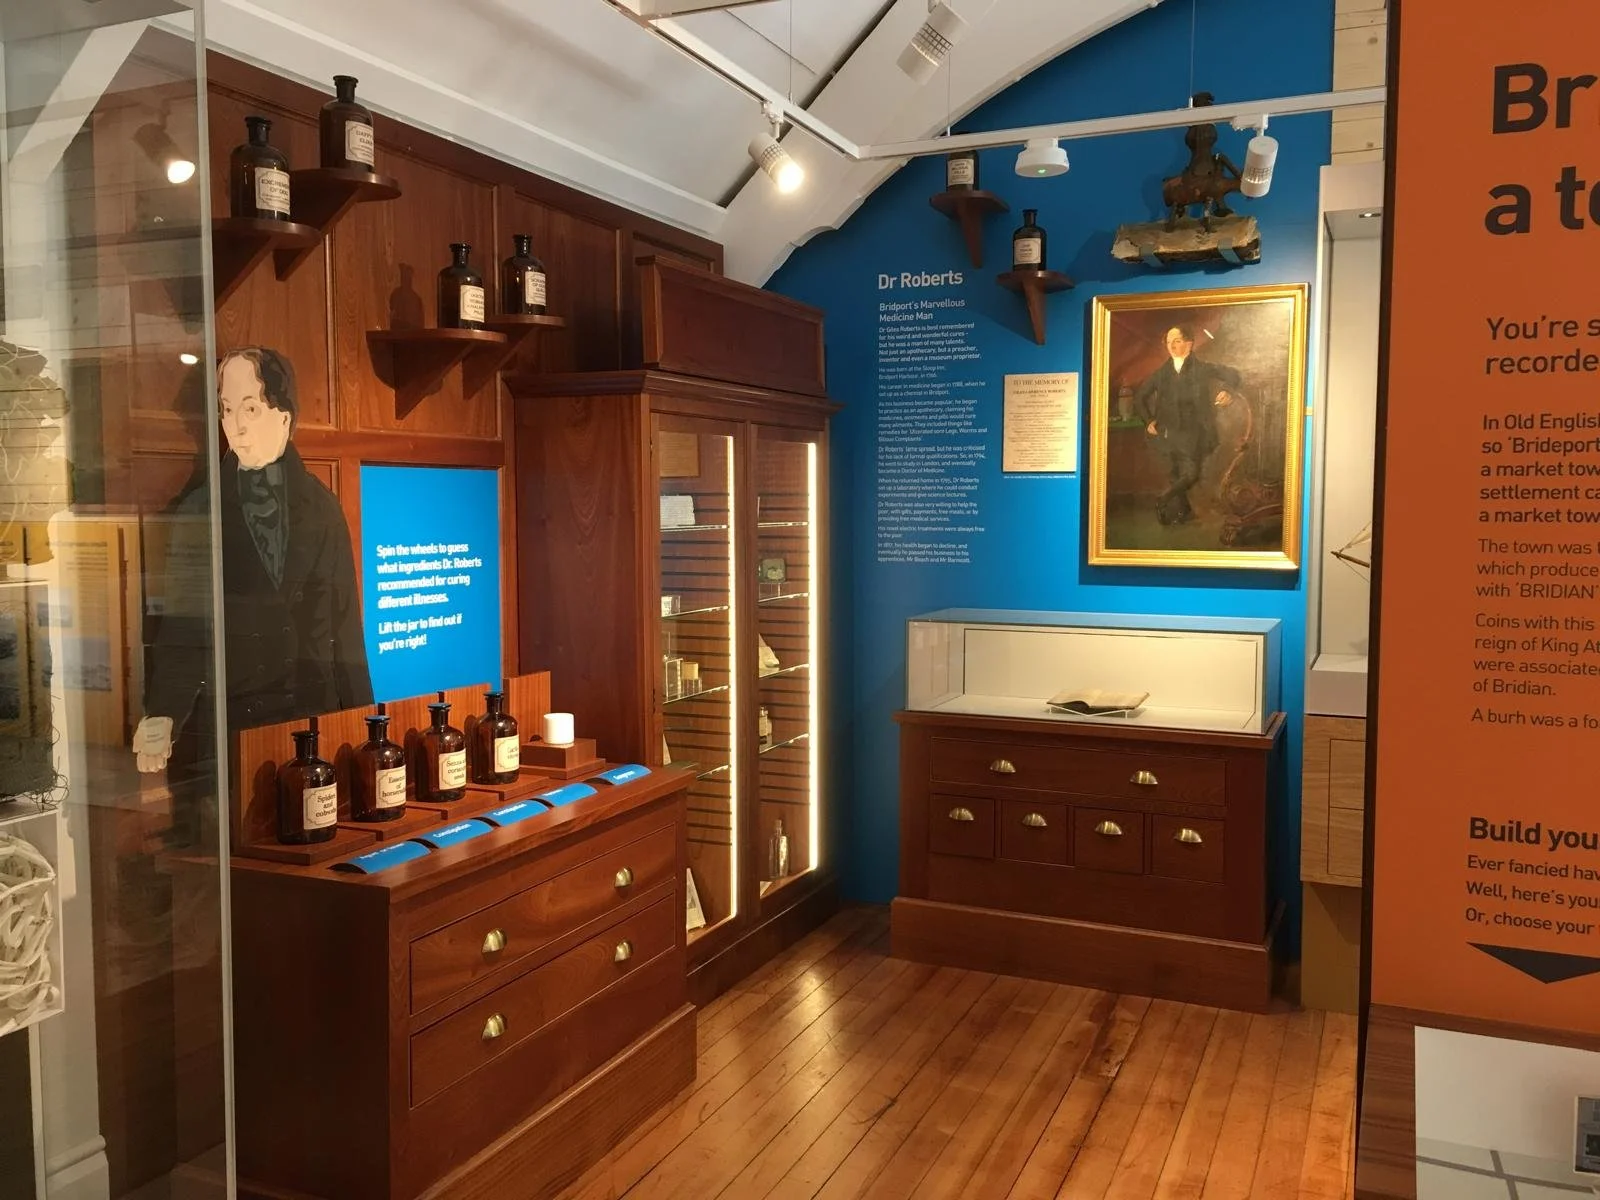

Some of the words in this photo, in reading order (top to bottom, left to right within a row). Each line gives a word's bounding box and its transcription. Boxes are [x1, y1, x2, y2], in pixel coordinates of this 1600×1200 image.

[1485, 184, 1531, 235] a
[1555, 166, 1600, 230] t
[878, 274, 897, 289] Dr
[900, 270, 963, 288] Roberts
[880, 301, 918, 312] Bridport's
[921, 299, 965, 309] Marvellous
[880, 314, 914, 322] Medicine
[916, 312, 933, 320] Man
[1486, 315, 1579, 339] You're
[1486, 349, 1598, 375] recorde
[1483, 415, 1499, 430] In
[1504, 414, 1534, 430] Old
[1540, 413, 1600, 432] Englis
[1482, 440, 1502, 453] so
[1481, 465, 1491, 476] a
[1496, 462, 1563, 476] market
[1569, 462, 1600, 476] tow
[1480, 484, 1580, 500] settlement
[1479, 512, 1489, 523] a
[1495, 508, 1561, 523] market
[1567, 509, 1600, 523] tow
[377, 545, 395, 559] Spin
[396, 544, 409, 555] the
[410, 543, 438, 554] wheels
[439, 543, 446, 553] to
[447, 544, 468, 555] guess
[1478, 539, 1508, 553] The
[1513, 540, 1553, 554] town
[1558, 542, 1591, 555] was
[377, 562, 397, 573] what
[399, 560, 441, 574] ingredients
[443, 559, 453, 569] Dr.
[454, 557, 482, 568] Roberts
[1477, 561, 1524, 576] which
[1530, 563, 1599, 579] produce
[378, 575, 434, 591] recommended
[436, 575, 446, 585] for
[447, 574, 470, 586] curing
[1476, 583, 1510, 597] with
[378, 595, 412, 609] different
[414, 593, 449, 605] illnesses.
[379, 622, 392, 634] Lift
[393, 621, 406, 632] the
[407, 620, 418, 633] jar
[420, 619, 427, 628] to
[429, 616, 443, 628] find
[444, 615, 456, 625] out
[457, 613, 462, 624] if
[1475, 613, 1520, 628] Coins
[1524, 615, 1558, 630] with
[1564, 616, 1594, 631] this
[379, 638, 404, 654] you're
[406, 634, 426, 649] right!
[1475, 636, 1516, 654] reign
[1521, 637, 1536, 651] of
[1542, 638, 1579, 656] King
[1473, 660, 1515, 671] were
[1520, 659, 1600, 675] associate
[1473, 679, 1488, 692] of
[1493, 679, 1556, 696] Bridian.
[1471, 708, 1483, 722] A
[1488, 709, 1525, 724] burh
[1530, 714, 1564, 727] was
[1568, 717, 1577, 727] a
[1470, 817, 1541, 844] Build
[1548, 830, 1598, 851] you
[1468, 855, 1504, 871] Ever
[1509, 859, 1569, 877] fancied
[1466, 881, 1507, 900] Well,
[1512, 886, 1564, 904] here's
[1569, 895, 1600, 909] you
[1466, 908, 1489, 925] Or,
[1494, 912, 1552, 929] choose
[1556, 921, 1595, 935] your
